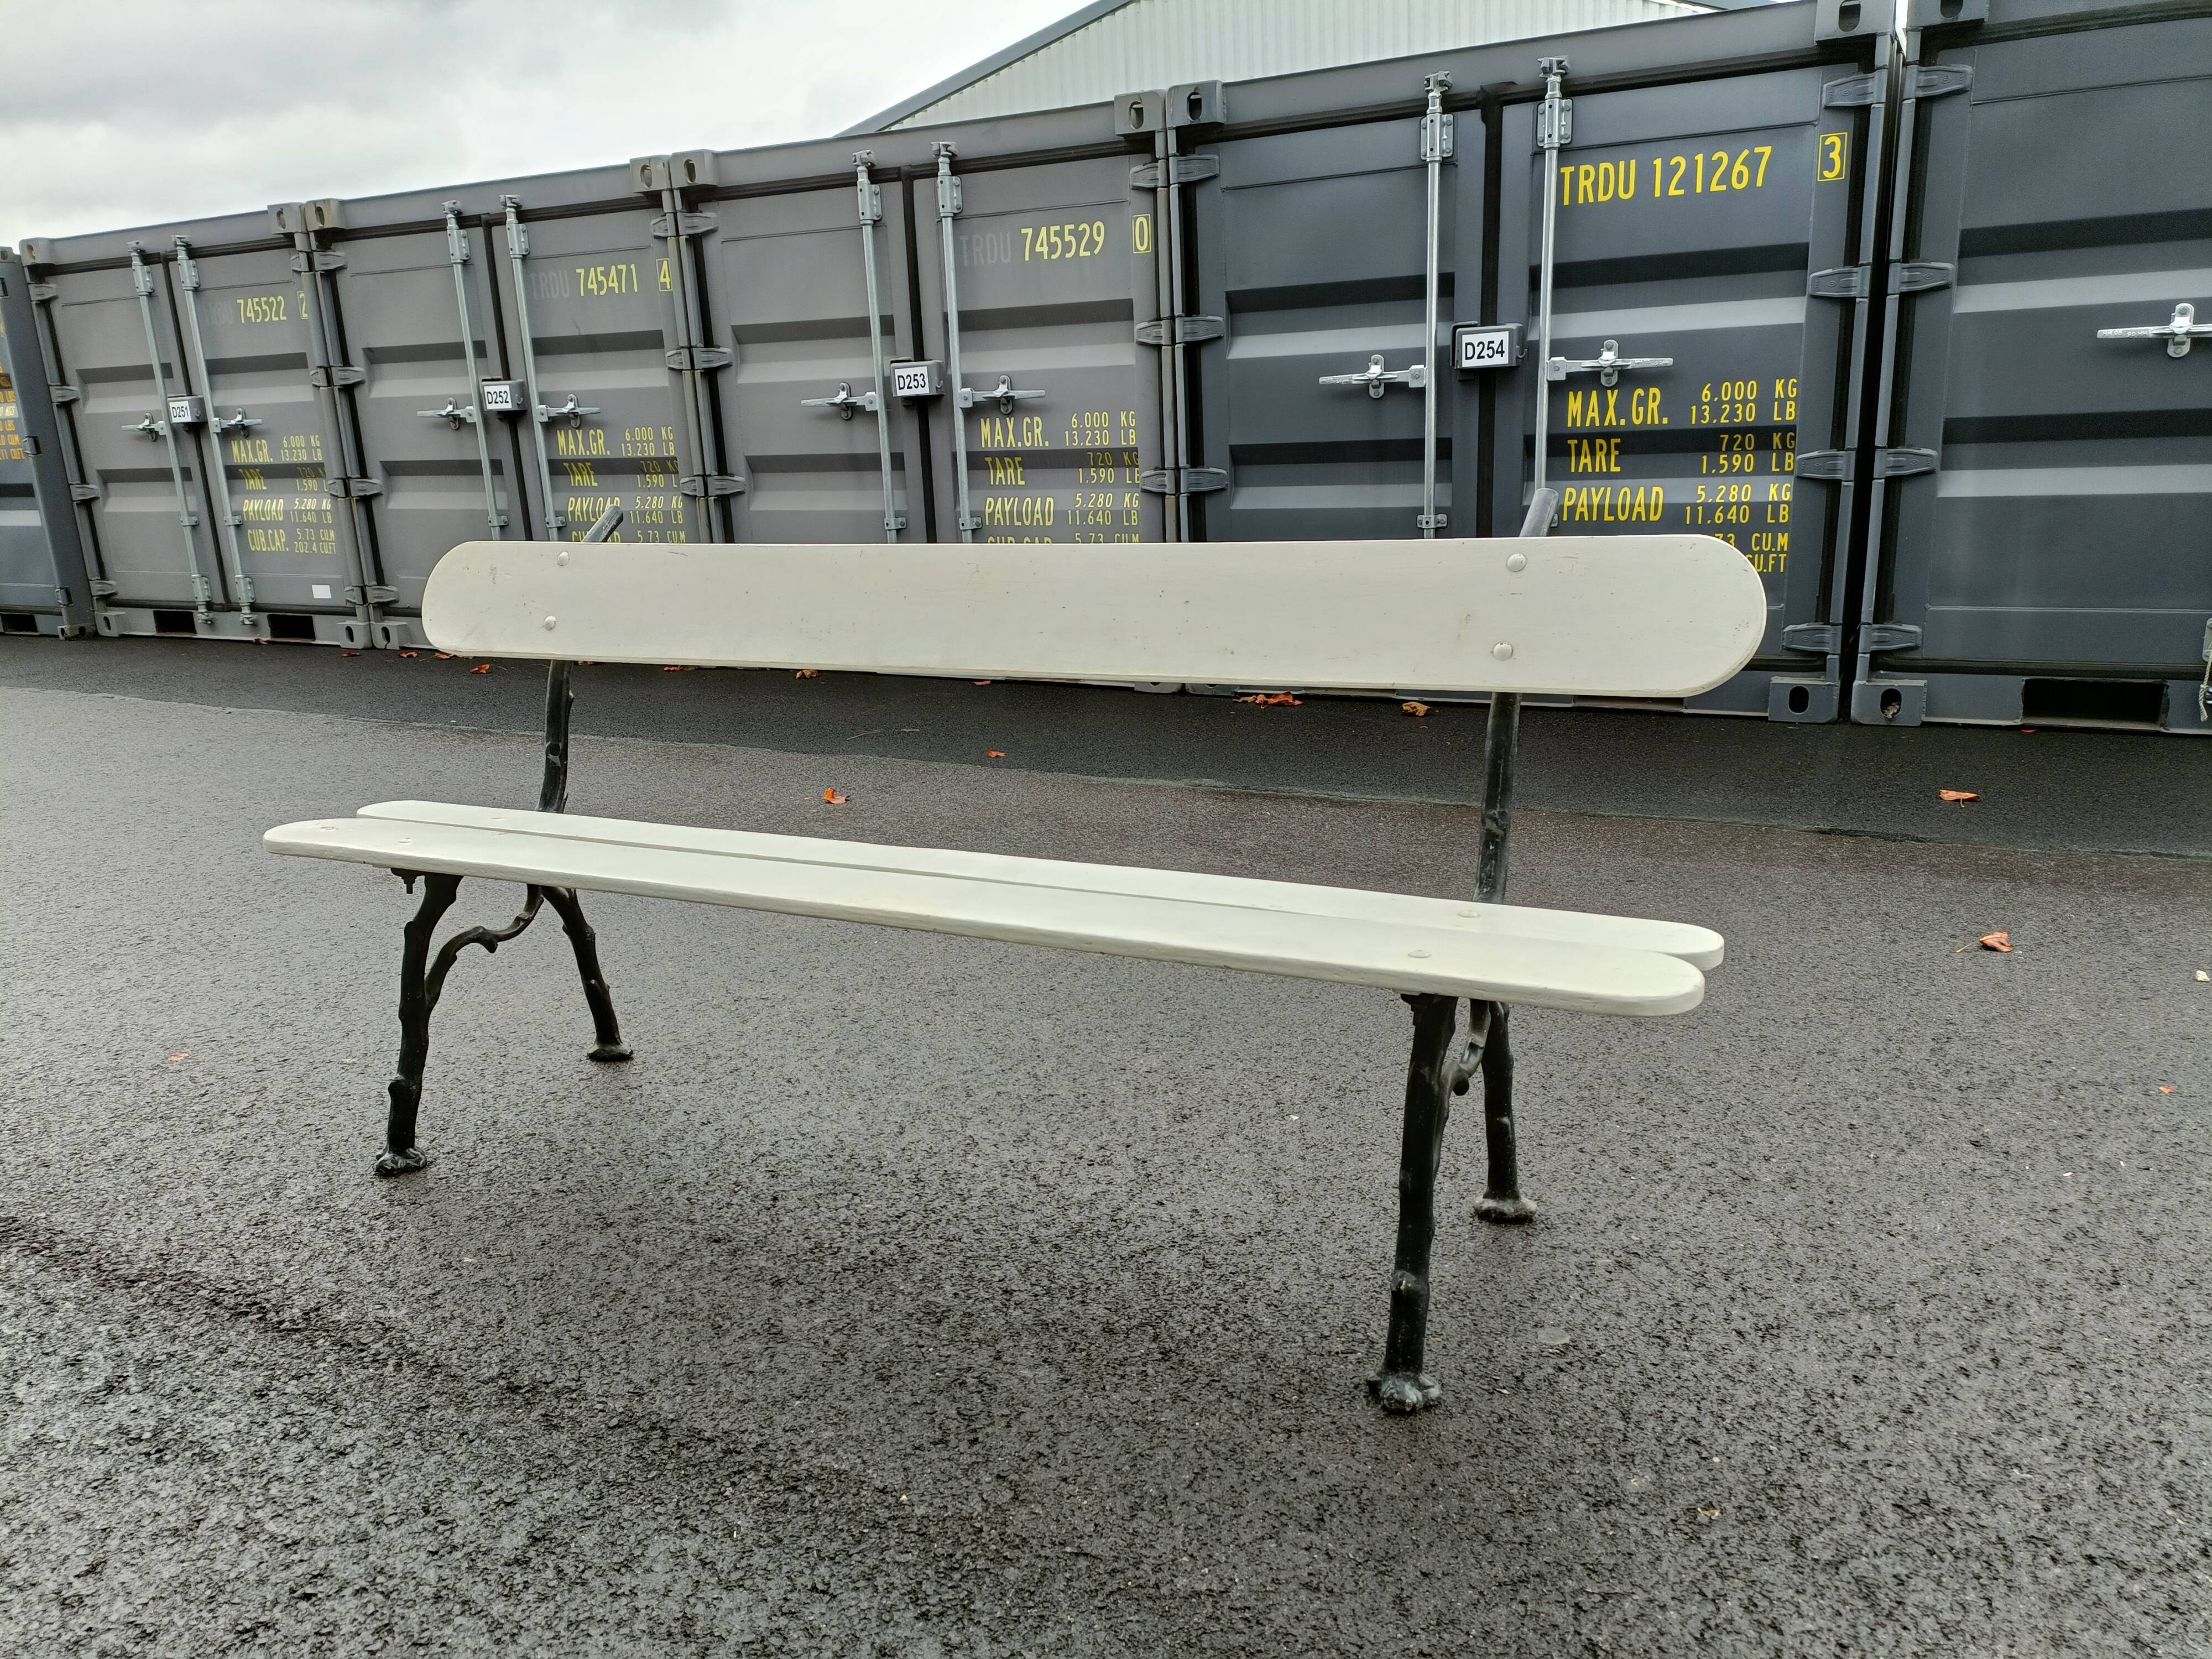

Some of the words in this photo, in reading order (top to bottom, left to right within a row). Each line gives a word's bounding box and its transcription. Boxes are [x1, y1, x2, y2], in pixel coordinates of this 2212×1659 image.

[1823, 136, 1841, 178] 3
[1561, 159, 1636, 205] TRDU
[1653, 146, 1772, 197] 121267
[1021, 221, 1105, 261] 745529
[1135, 216, 1149, 251] 0
[576, 264, 638, 296] 745471
[660, 260, 670, 289] 4
[237, 295, 287, 323] 745522
[299, 293, 308, 318] 2
[1465, 339, 1505, 361] D254
[897, 373, 926, 390] D253
[1775, 378, 1797, 399] KG
[487, 390, 509, 404] D252
[1567, 387, 1669, 427] MAX.GR.
[171, 406, 189, 418] D251
[1120, 411, 1135, 427] KG
[1773, 400, 1796, 421] LB
[310, 435, 320, 447] KG
[661, 426, 674, 440] KG
[980, 416, 1049, 447] MAX.GR.
[1121, 429, 1136, 445] LB
[231, 439, 273, 463] MAX.GR.
[556, 429, 611, 456] MAX.GR.
[663, 442, 675, 456] LB
[1720, 434, 1755, 452] 720
[1773, 432, 1796, 450] KG
[312, 448, 322, 461] LB
[1087, 451, 1113, 466] 720
[1123, 451, 1139, 466] KG
[1567, 438, 1621, 473] TARE
[1771, 452, 1794, 472] LB
[297, 467, 316, 478] 720
[563, 462, 598, 487] TARE
[640, 460, 661, 473] 720
[984, 457, 1025, 486] TARE
[239, 469, 267, 491] TARE
[671, 495, 682, 509] KG
[1124, 493, 1139, 508] KG
[1768, 483, 1792, 501] KG
[243, 499, 284, 521] PAYLOAD
[321, 498, 331, 510] KG
[985, 497, 1054, 526] PAYLOAD
[1563, 487, 1664, 521] PAYLOAD
[1767, 504, 1790, 524] LB
[322, 512, 332, 524] LB
[671, 510, 683, 524] LB
[1123, 510, 1138, 525] LB
[247, 529, 289, 551] CUB.CAP.
[296, 529, 315, 540] 5.73
[1751, 533, 1788, 551] CU.M
[294, 541, 317, 553] 202.4
